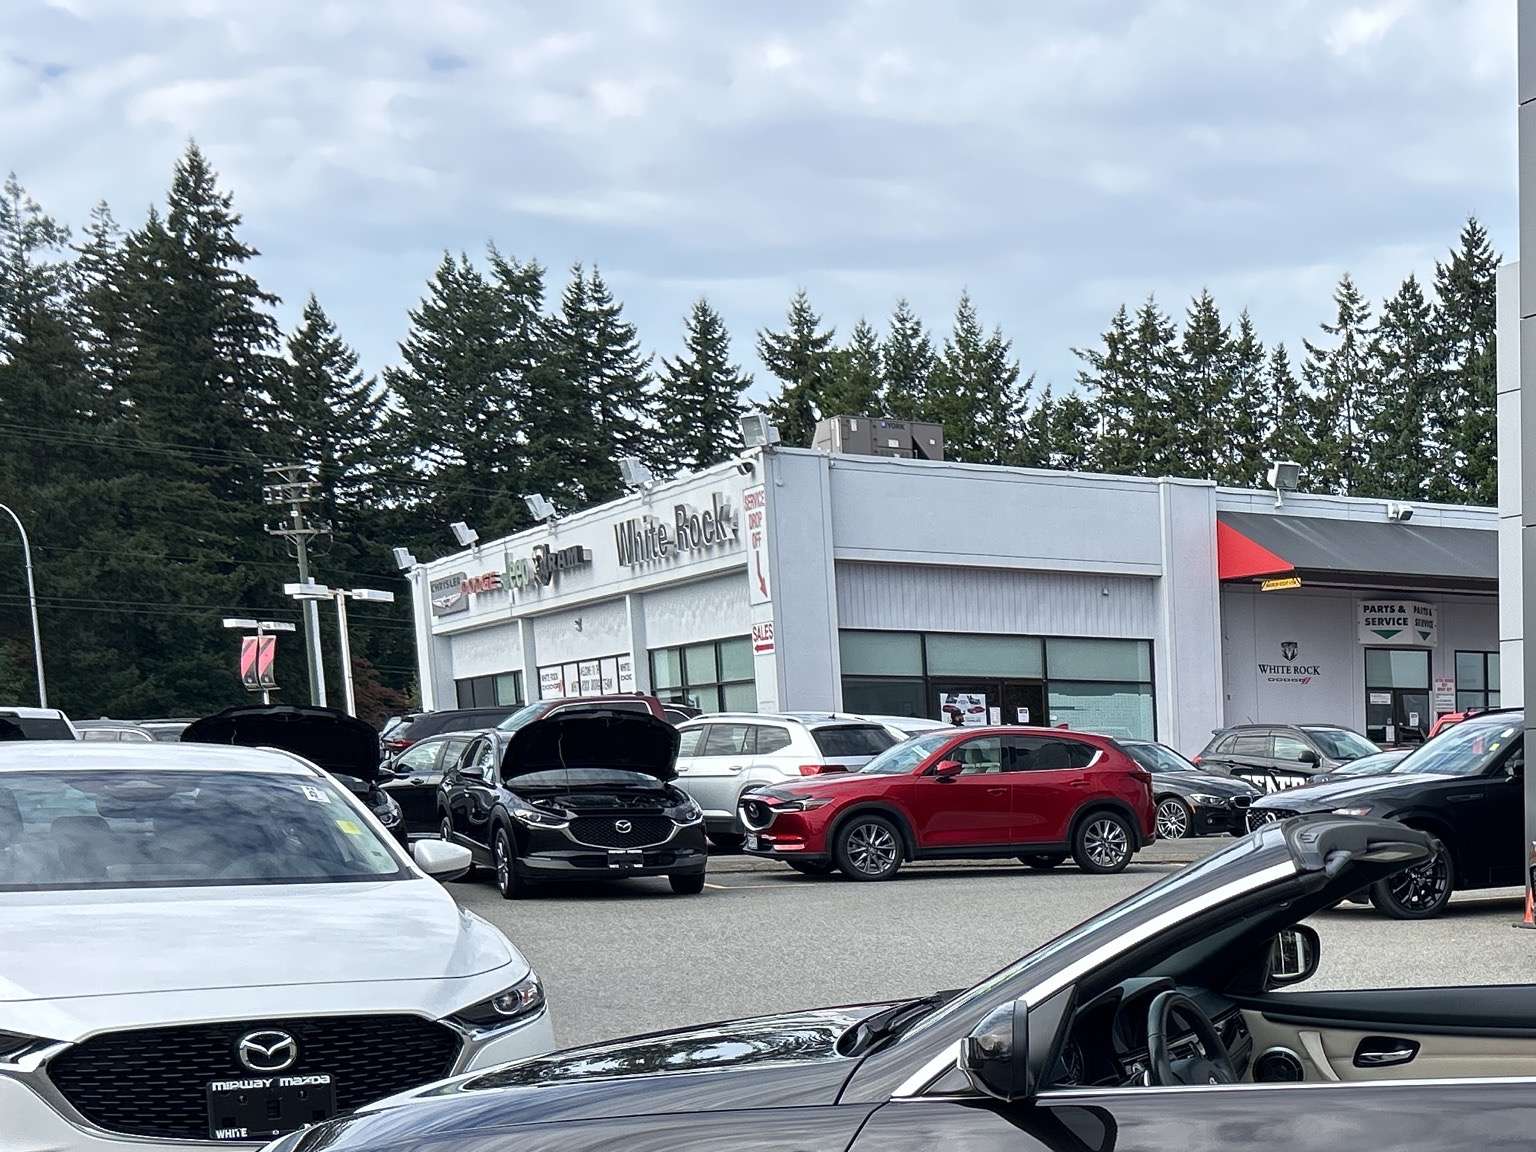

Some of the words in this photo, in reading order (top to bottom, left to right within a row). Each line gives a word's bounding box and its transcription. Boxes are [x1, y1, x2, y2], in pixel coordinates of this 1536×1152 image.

[744, 490, 766, 511] SERVICE
[614, 514, 669, 567] White
[430, 576, 461, 593] CHRYSLER
[1363, 605, 1396, 614] PARTS
[1398, 605, 1406, 614] &
[1413, 605, 1428, 615] PARTS
[1365, 617, 1409, 626] SERVICE
[1415, 618, 1434, 629] SERVICE
[752, 624, 774, 642] SALES
[1258, 664, 1292, 675] WHITE
[1293, 665, 1321, 676] ROCK
[215, 1127, 248, 1139] WHITE
